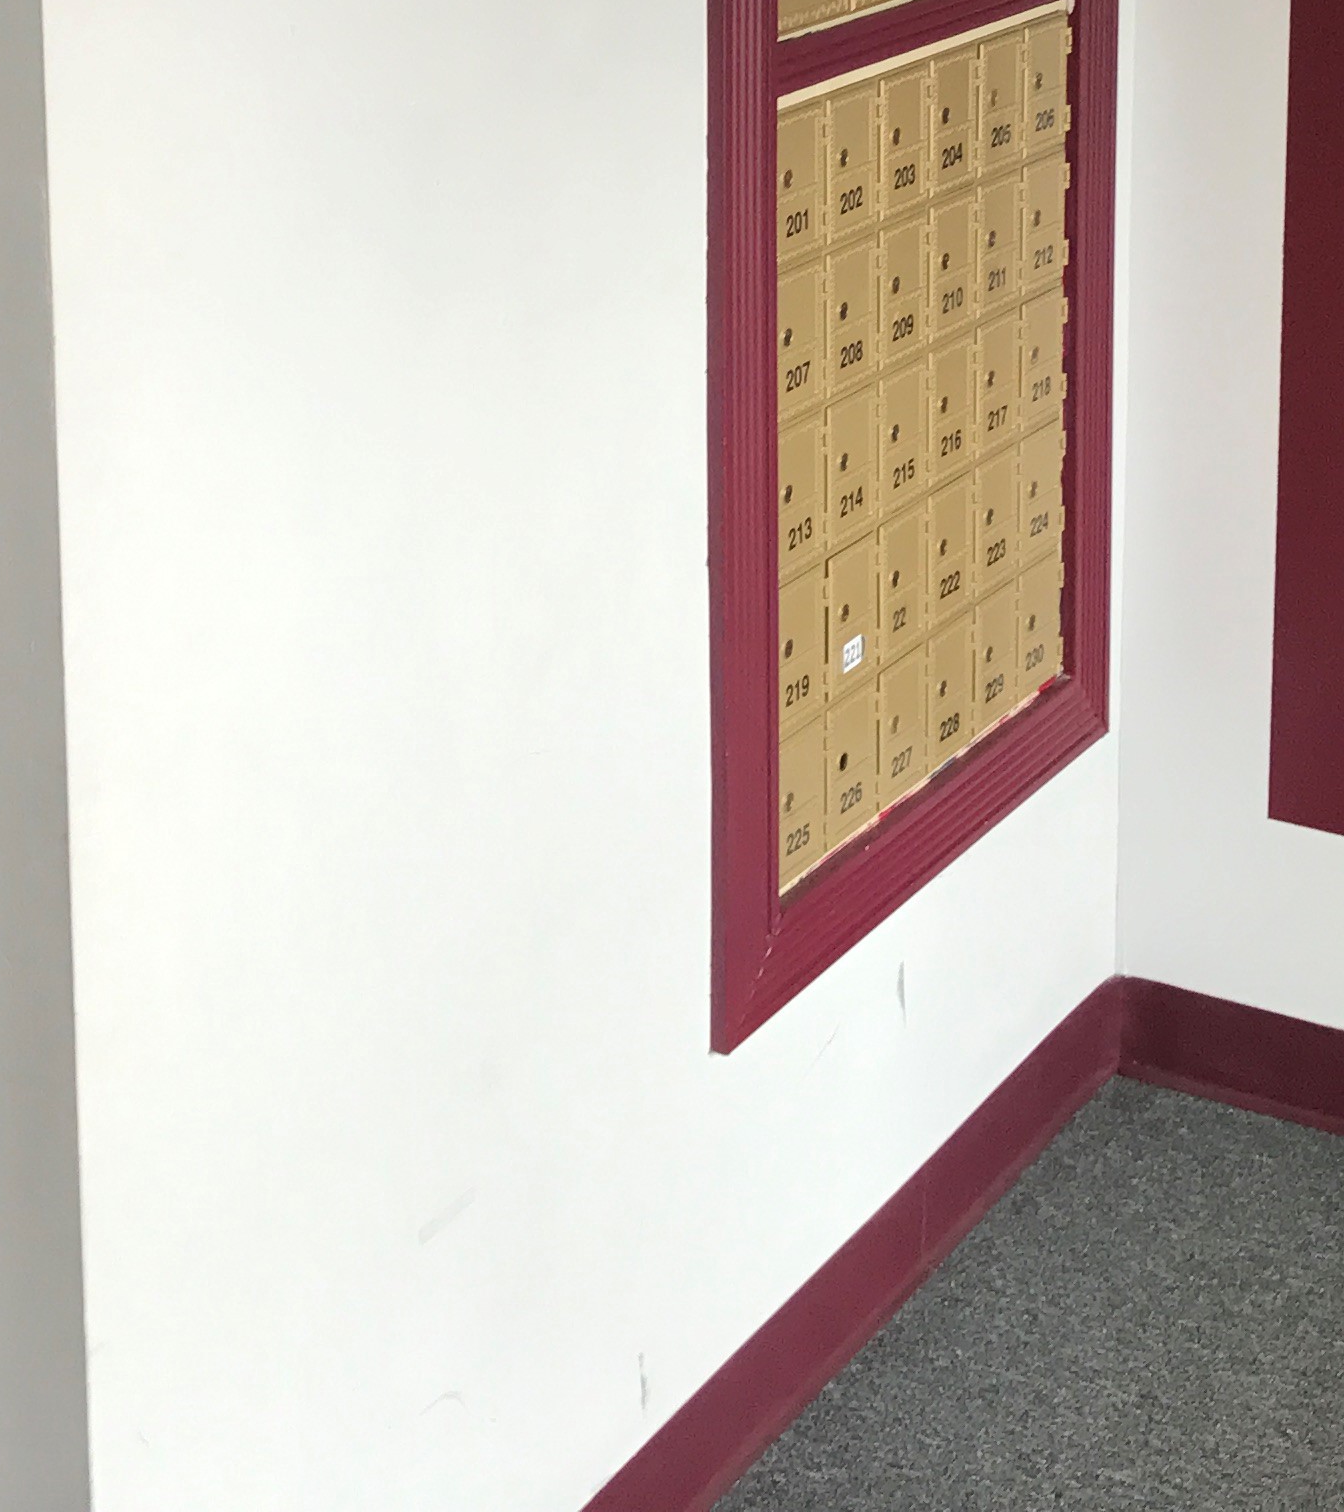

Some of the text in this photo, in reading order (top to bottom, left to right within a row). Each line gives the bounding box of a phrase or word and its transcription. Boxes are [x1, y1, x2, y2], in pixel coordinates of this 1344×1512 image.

[1035, 108, 1054, 132] 206
[991, 124, 1010, 148] 205
[942, 143, 963, 169] 204
[894, 164, 915, 190] 203
[840, 186, 863, 215] 202
[786, 209, 808, 238] 201
[1034, 245, 1053, 269] 212
[988, 268, 1006, 292] 211
[942, 287, 963, 314] 210
[892, 314, 914, 342] 209
[840, 340, 863, 368] 208
[786, 361, 810, 392] 207
[1032, 376, 1051, 402] 218
[987, 405, 1008, 431] 217
[941, 429, 961, 457] 216
[893, 458, 915, 489] 215
[840, 487, 863, 518] 214
[788, 517, 812, 551] 213
[1030, 512, 1049, 537] 224
[987, 539, 1005, 567] 223
[940, 571, 960, 599] 222
[1026, 644, 1044, 671] 230
[786, 675, 810, 707] 219
[985, 674, 1003, 704] 229
[940, 713, 960, 742] 228
[891, 746, 912, 778] 227
[840, 782, 862, 814] 226
[786, 823, 810, 856] 225
